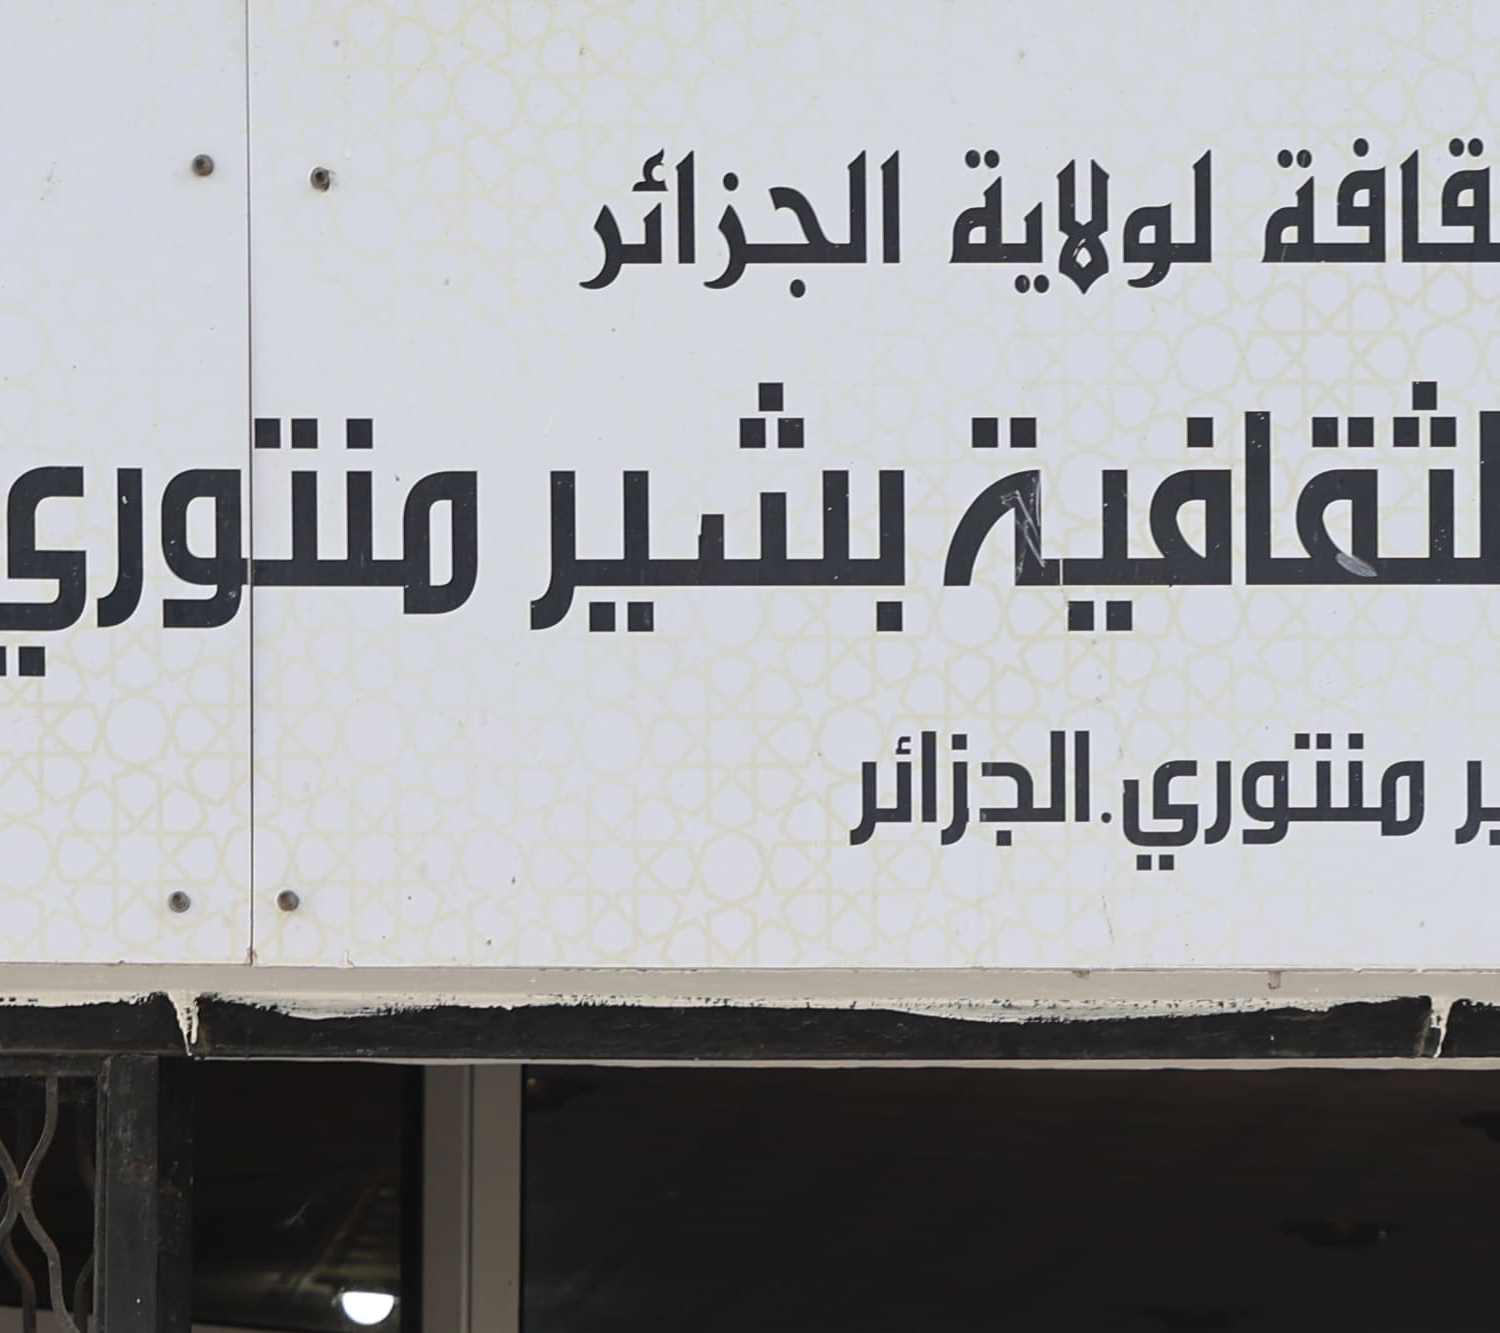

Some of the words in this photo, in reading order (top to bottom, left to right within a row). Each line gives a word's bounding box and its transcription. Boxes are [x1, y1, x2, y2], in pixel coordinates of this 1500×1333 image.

[580, 150, 899, 297] الجزائر
[950, 150, 1211, 294] لولاية
[531, 383, 905, 632] بشير
